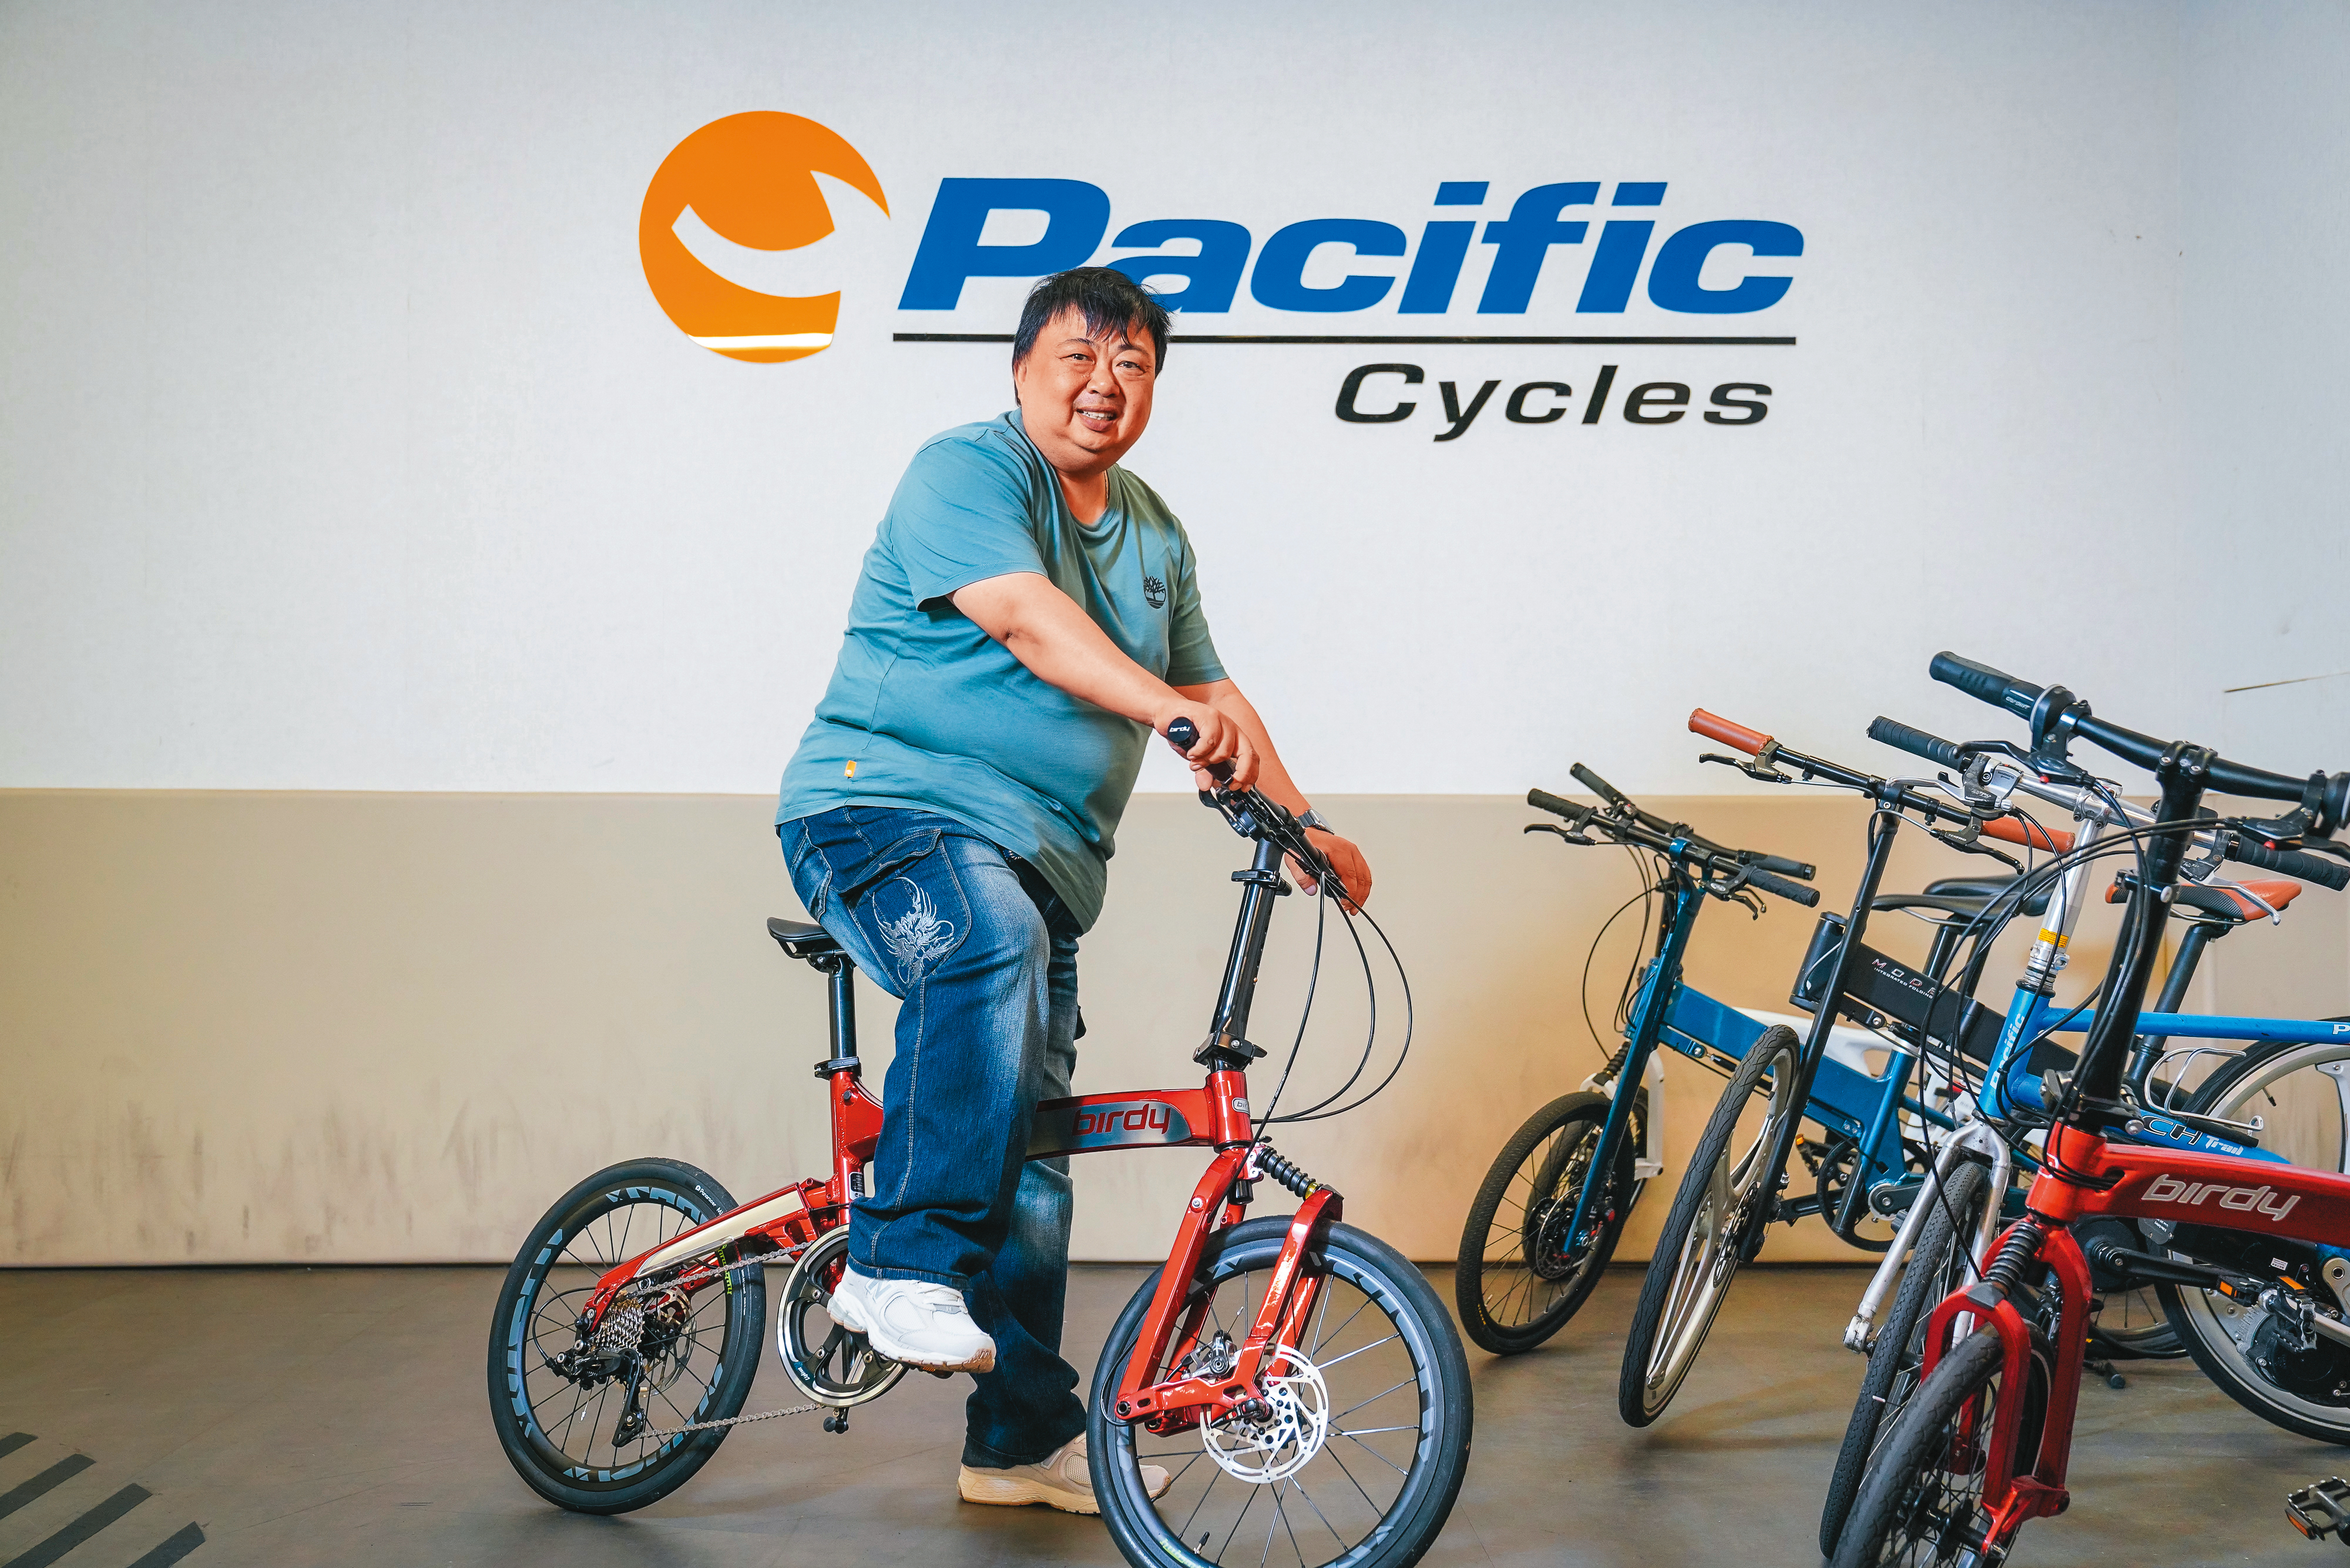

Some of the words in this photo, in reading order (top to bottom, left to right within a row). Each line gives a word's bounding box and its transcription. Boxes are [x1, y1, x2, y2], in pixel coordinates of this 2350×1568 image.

[898, 177, 1804, 314] Pacific
[1335, 363, 1772, 442] Cycles
[1998, 771, 2015, 779] SHIMANO
[1874, 967, 1908, 986] INTEGRATED
[1072, 1103, 1171, 1136] birdy
[2205, 1135, 2244, 1156] Trail
[699, 1188, 717, 1207] Panaracer
[2141, 1174, 2301, 1221] birdy
